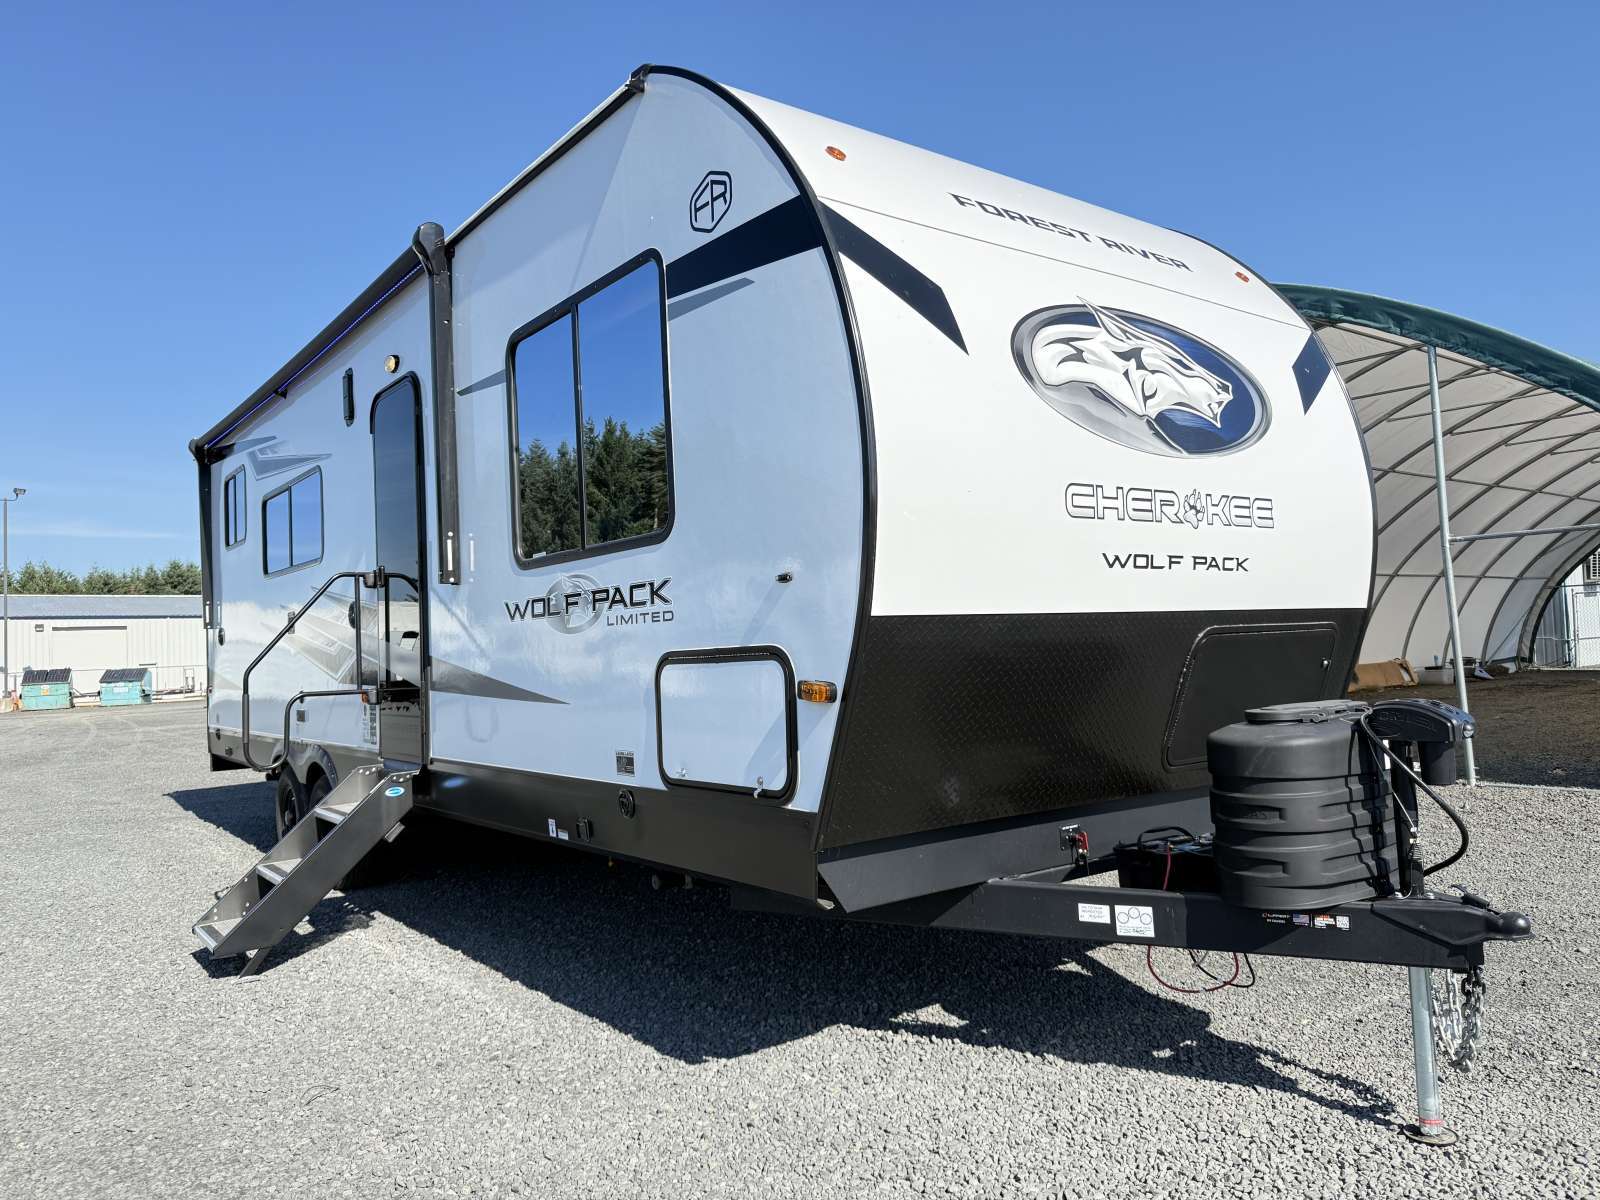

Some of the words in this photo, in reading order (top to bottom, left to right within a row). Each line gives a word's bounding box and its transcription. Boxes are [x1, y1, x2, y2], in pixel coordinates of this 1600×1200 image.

[950, 192, 1090, 242] FOREST
[1098, 236, 1193, 272] RIVER
[1102, 552, 1184, 570] WOLF
[1192, 555, 1249, 572] PACK
[505, 592, 582, 622] WOLF
[590, 577, 672, 614] PACK
[606, 610, 674, 626] LIMITED
